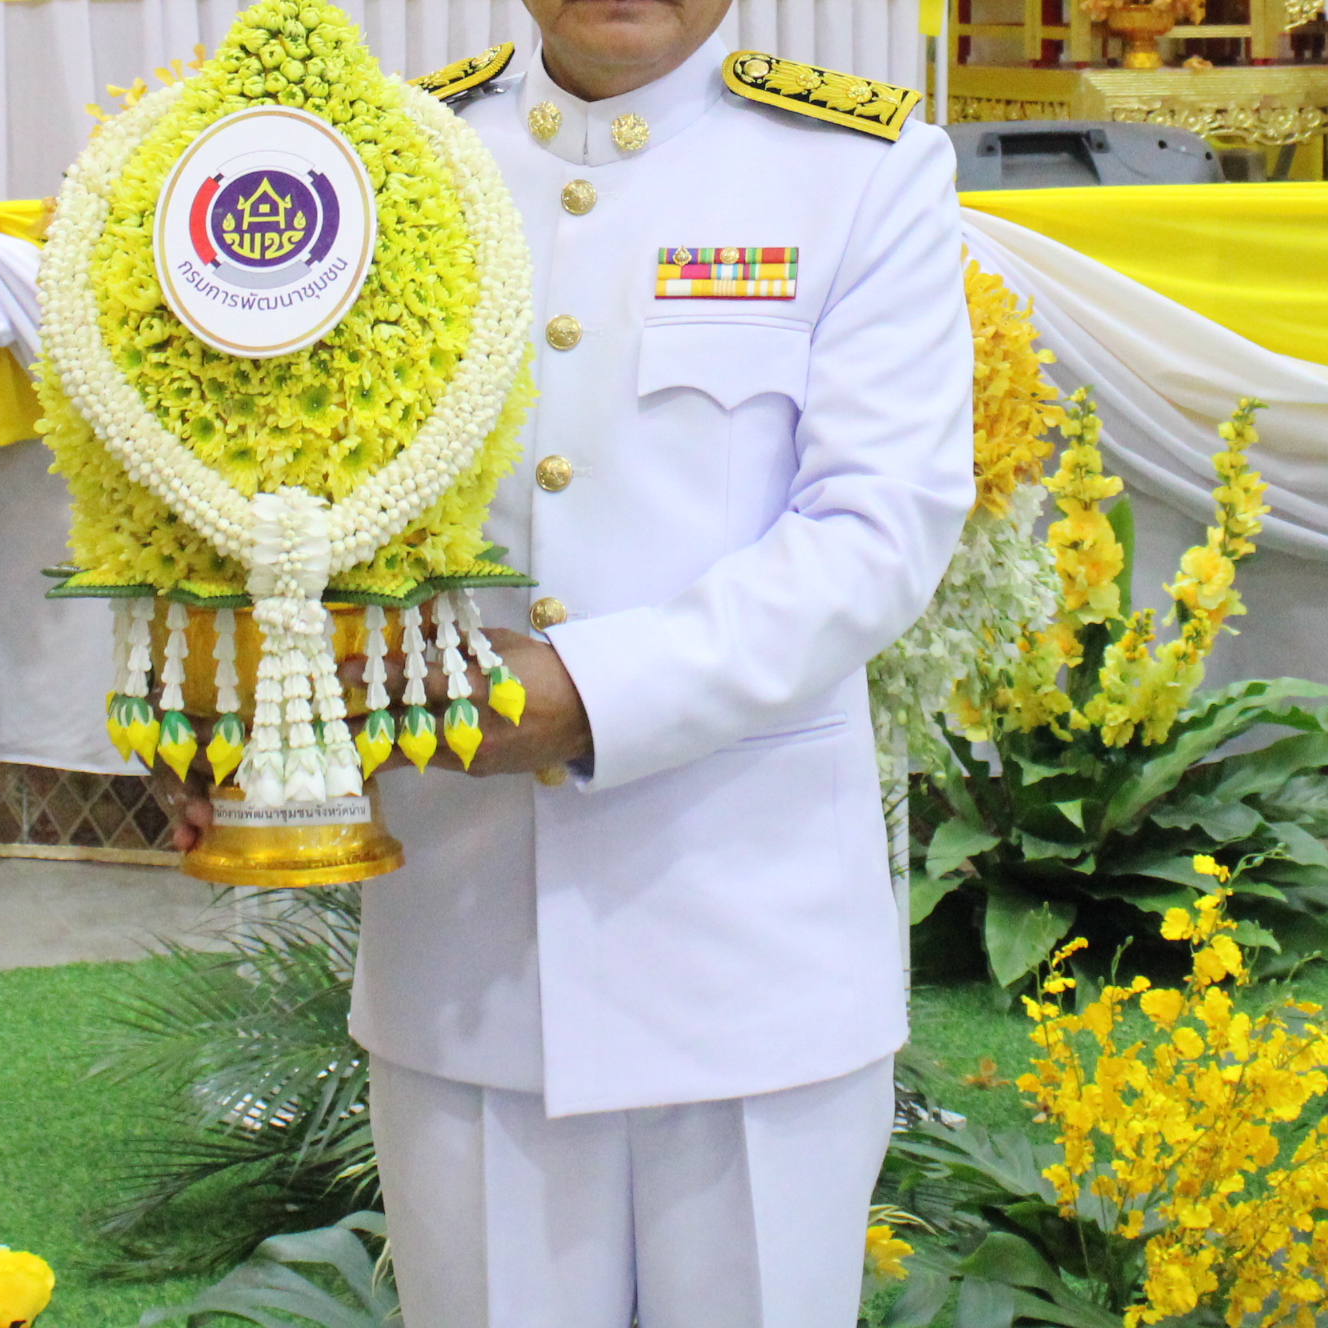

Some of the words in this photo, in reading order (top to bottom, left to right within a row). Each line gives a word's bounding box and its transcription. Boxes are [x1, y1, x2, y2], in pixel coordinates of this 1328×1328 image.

[177, 256, 349, 311] กรมการพัฒนาชุมชน
[214, 803, 366, 822] นักงานพัฒนาชุมชนจังหวัดน่าน
